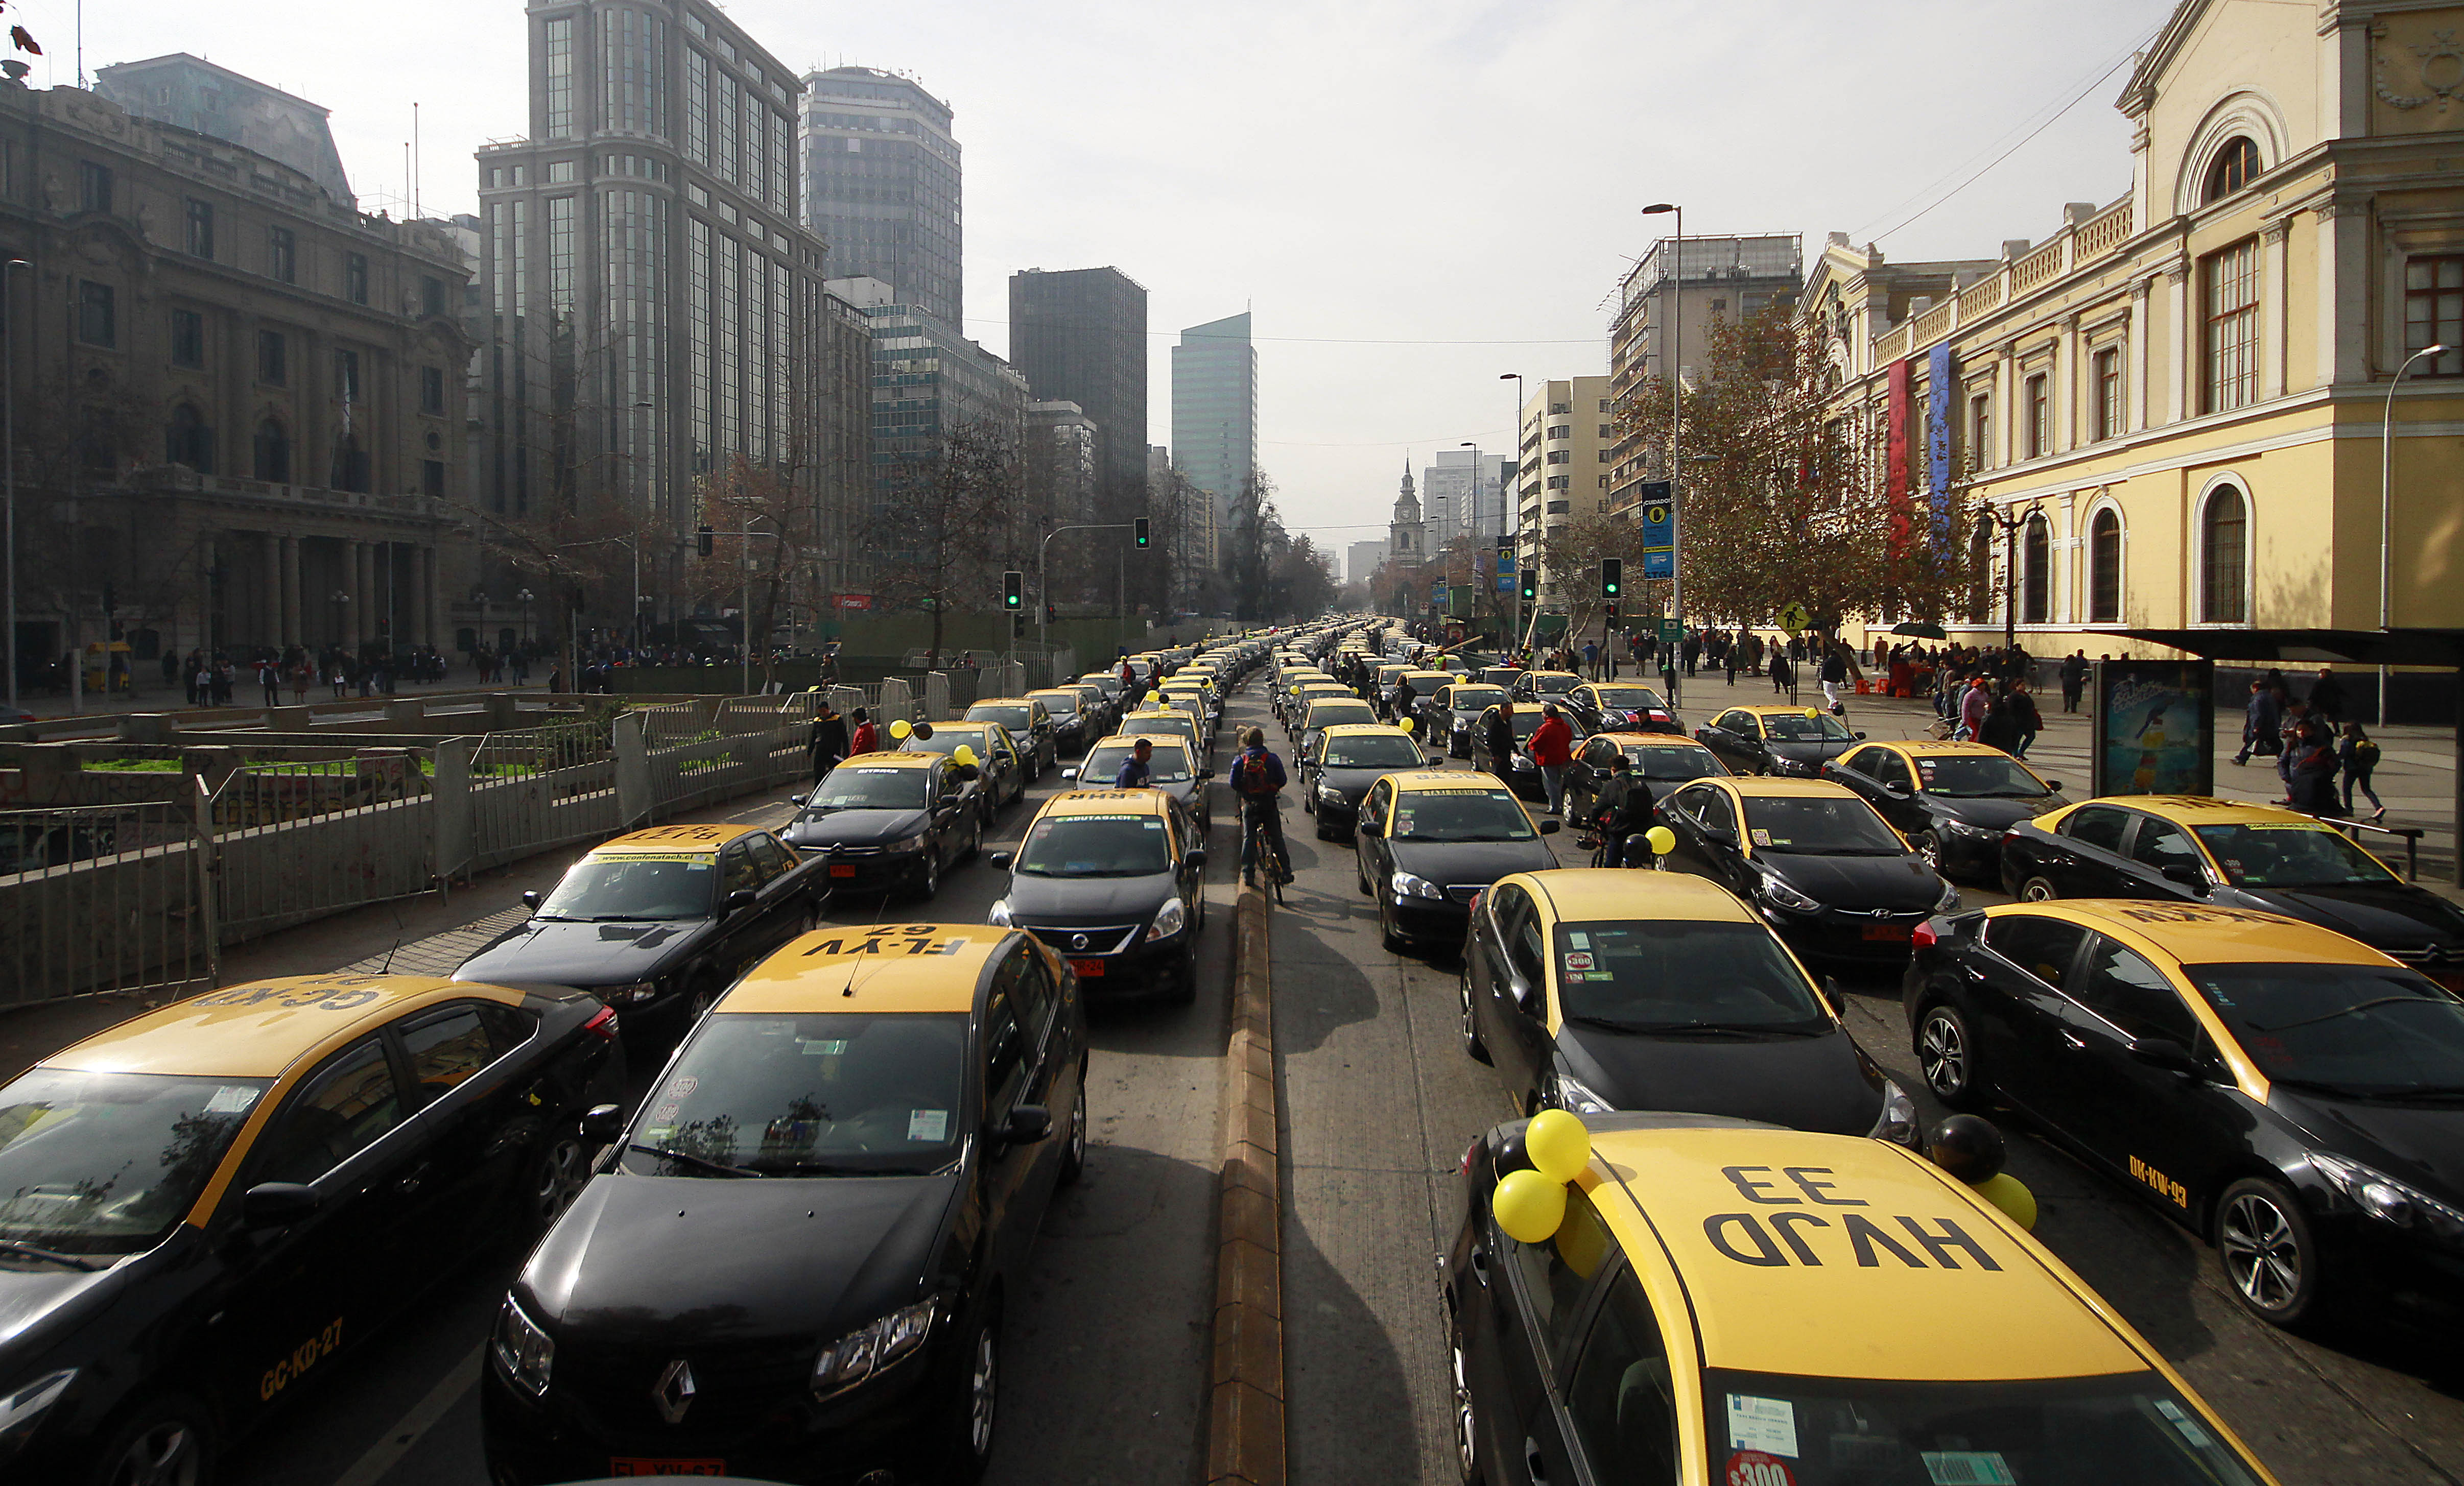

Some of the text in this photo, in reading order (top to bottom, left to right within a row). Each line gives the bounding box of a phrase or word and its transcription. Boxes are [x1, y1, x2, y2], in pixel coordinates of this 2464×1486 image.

[864, 926, 937, 936] 67
[1721, 1166, 1870, 1206] 33
[1703, 1212, 2004, 1272] HVJD
[261, 1316, 343, 1401] GC-KD-27
